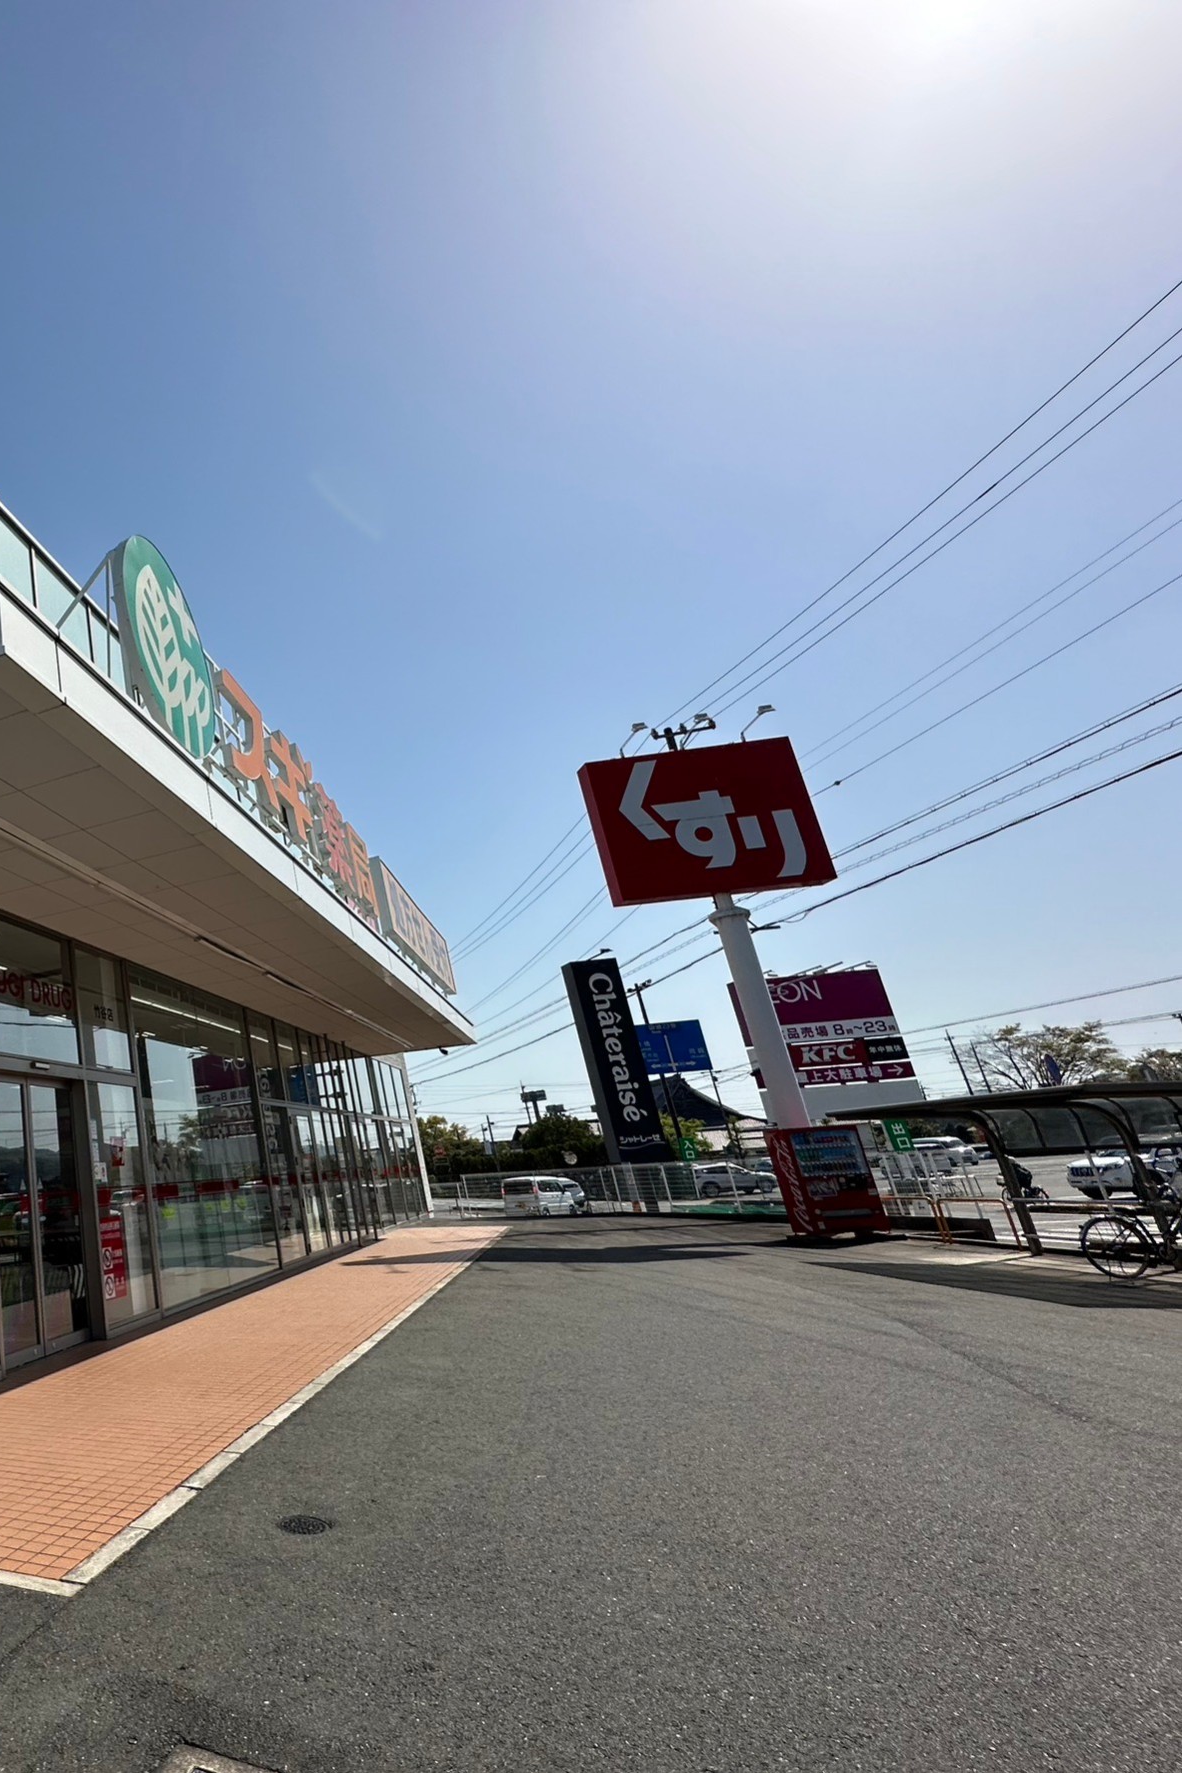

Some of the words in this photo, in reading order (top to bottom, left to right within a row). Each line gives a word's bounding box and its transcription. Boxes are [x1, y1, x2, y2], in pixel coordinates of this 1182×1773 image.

[619, 760, 806, 877] くすり
[30, 978, 74, 1011] DRUG
[782, 1025, 829, 1039] 品売場
[588, 972, 647, 1122] Châteraisé
[802, 1044, 855, 1064] KFC
[619, 1134, 662, 1145] シャトレーゼ
[891, 1123, 910, 1149] 出口
[684, 1140, 696, 1159] 入口
